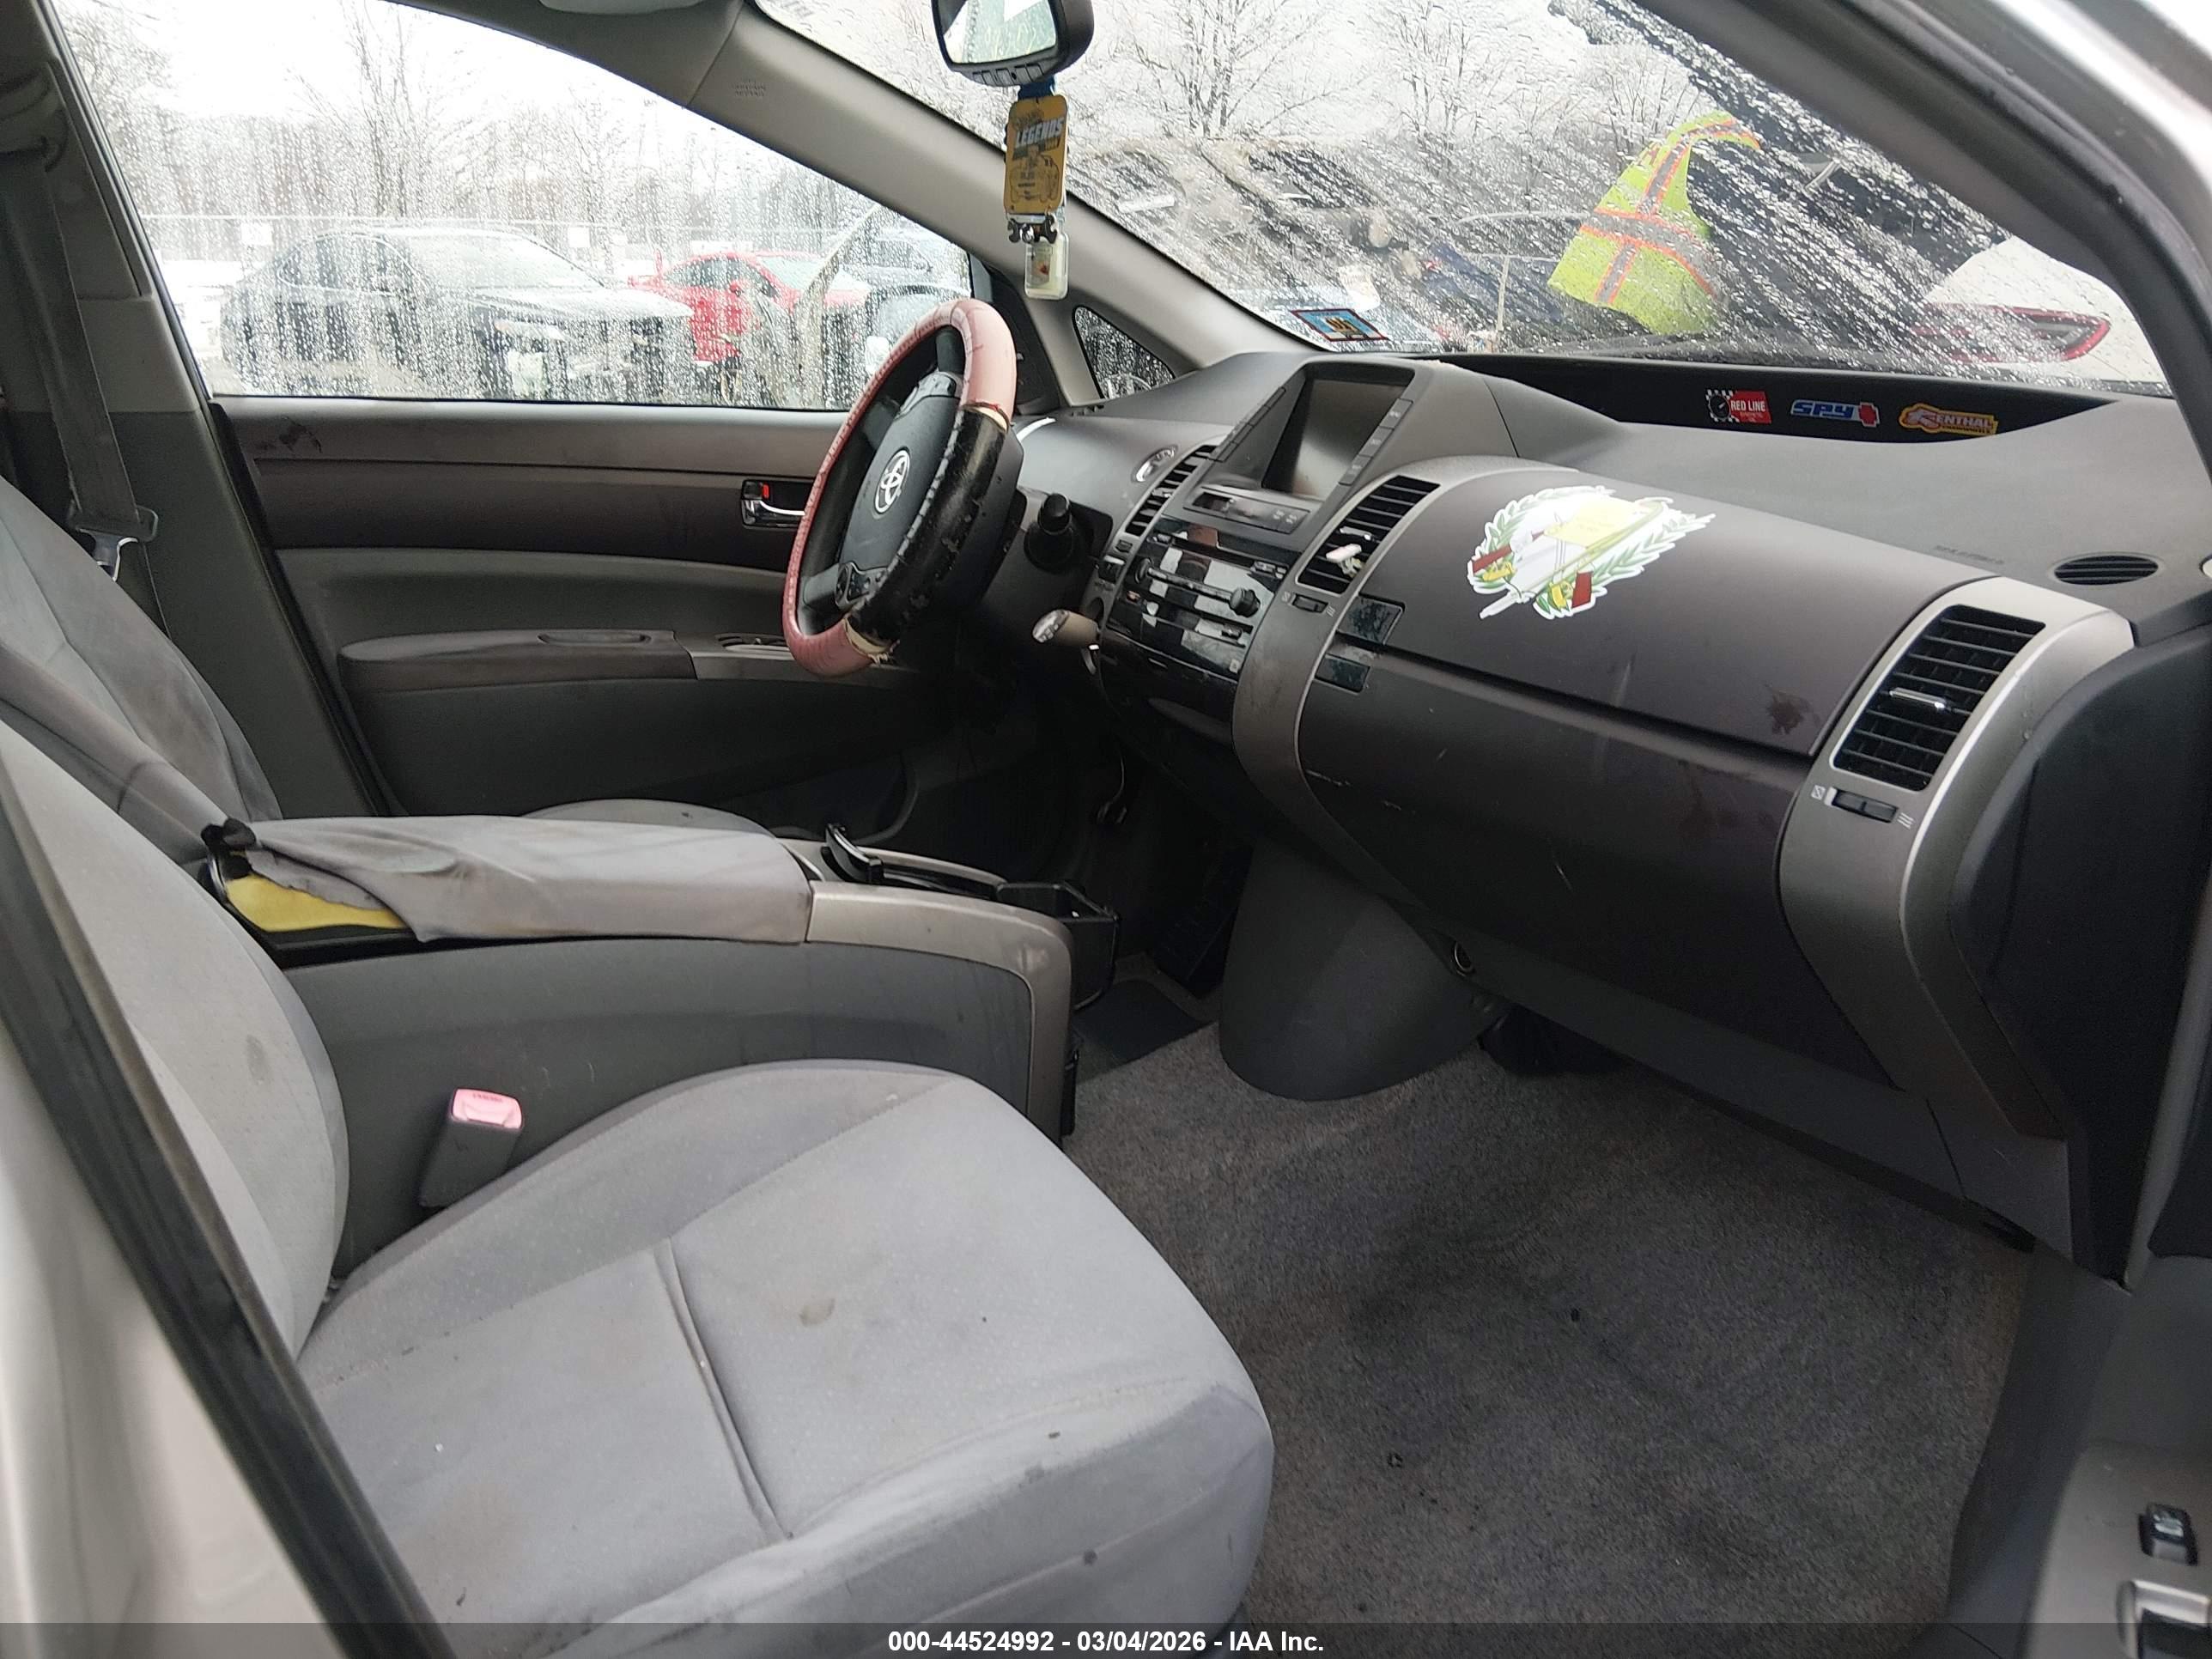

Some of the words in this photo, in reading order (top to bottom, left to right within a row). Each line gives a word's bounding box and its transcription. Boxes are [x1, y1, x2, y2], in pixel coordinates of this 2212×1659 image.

[1015, 117, 1064, 148] LEGENDS
[1730, 399, 1747, 411] RED
[1747, 400, 1766, 412] LINE
[1792, 401, 1855, 419] SPY
